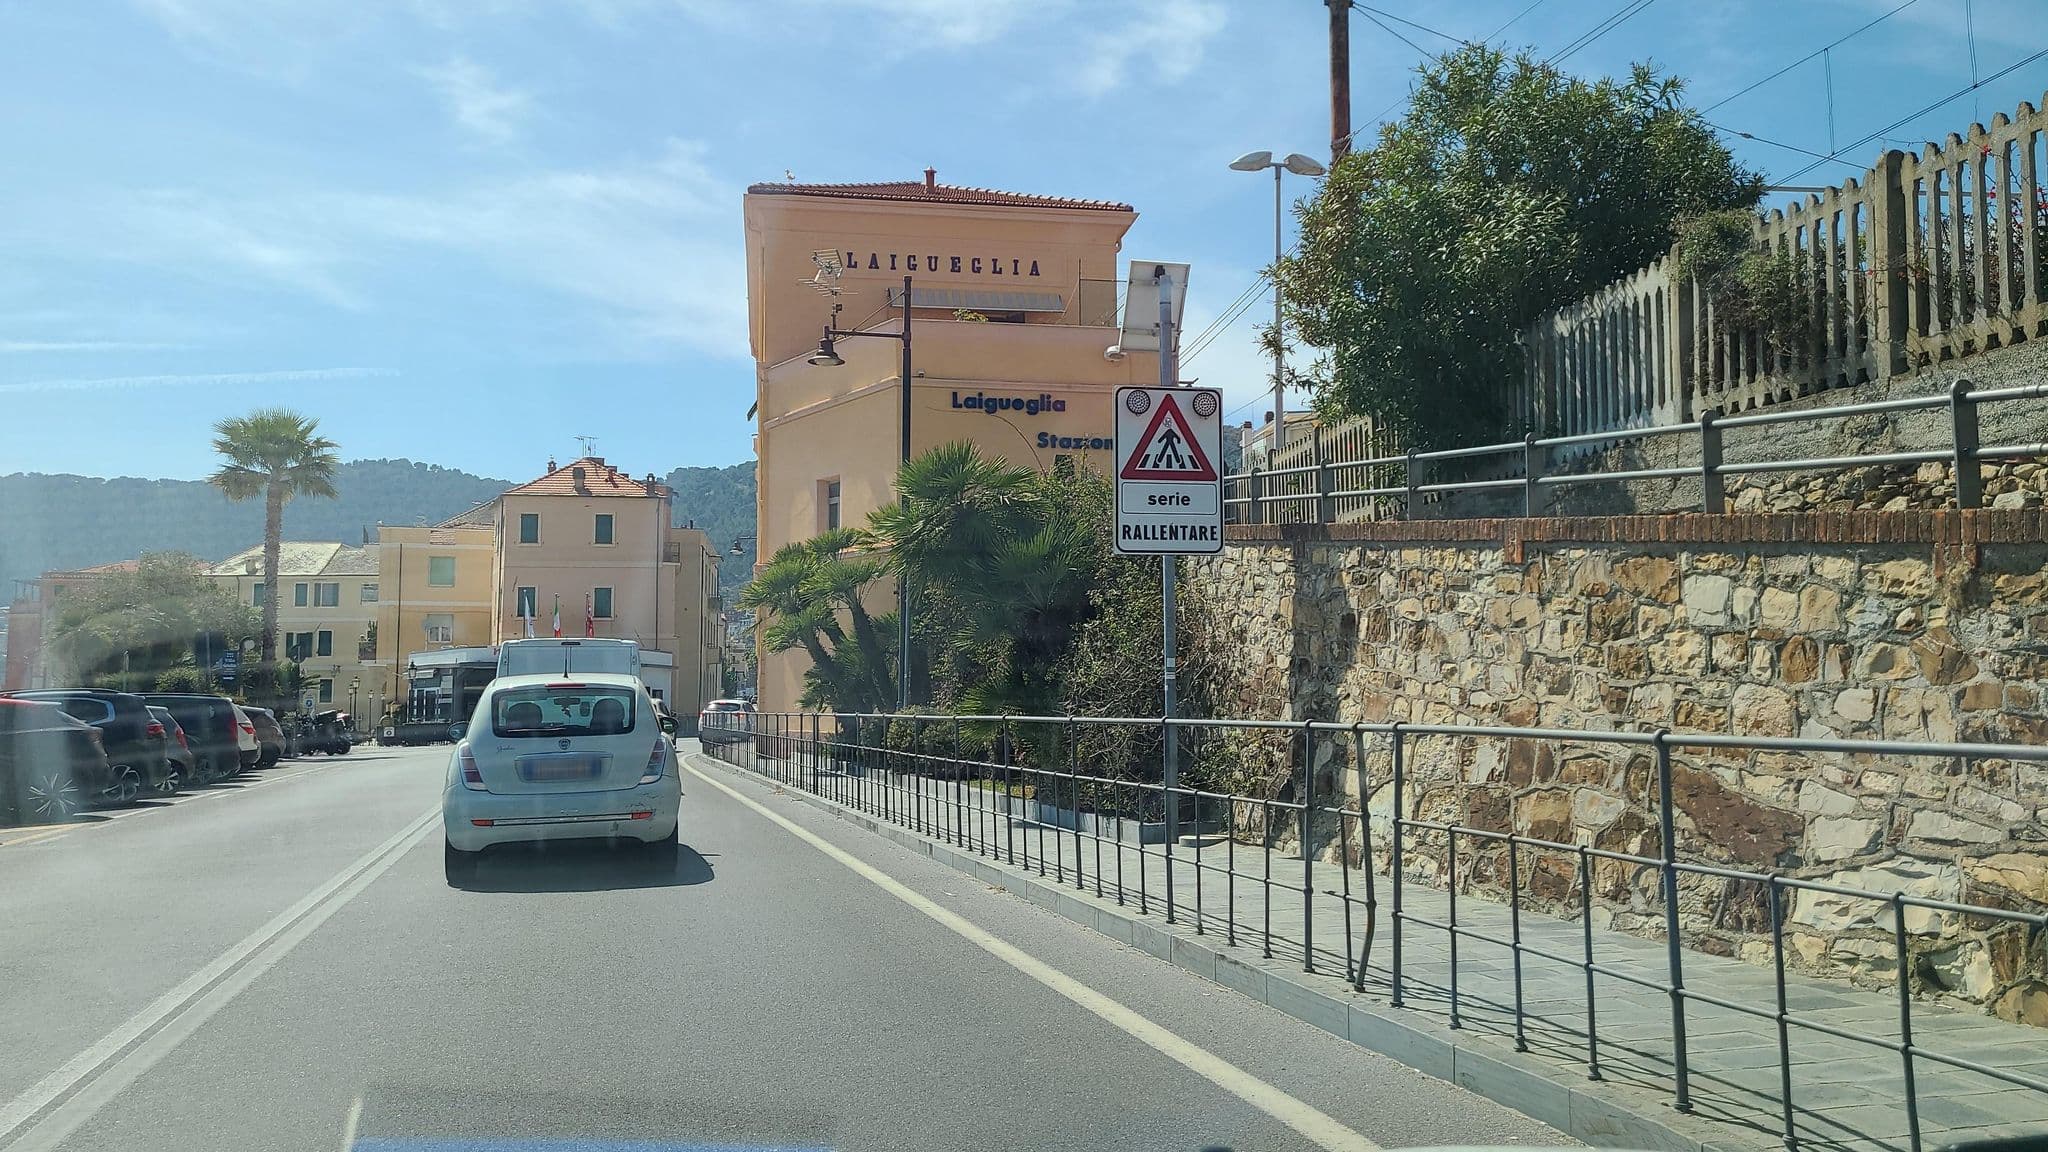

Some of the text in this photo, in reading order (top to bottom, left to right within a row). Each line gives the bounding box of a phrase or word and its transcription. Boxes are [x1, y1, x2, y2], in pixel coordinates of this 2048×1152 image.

[846, 252, 1041, 277] LAIGUEGLIA
[1037, 431, 1113, 450] Stazon
[1147, 491, 1191, 506] serie
[1122, 524, 1218, 541] RALLENTARE
